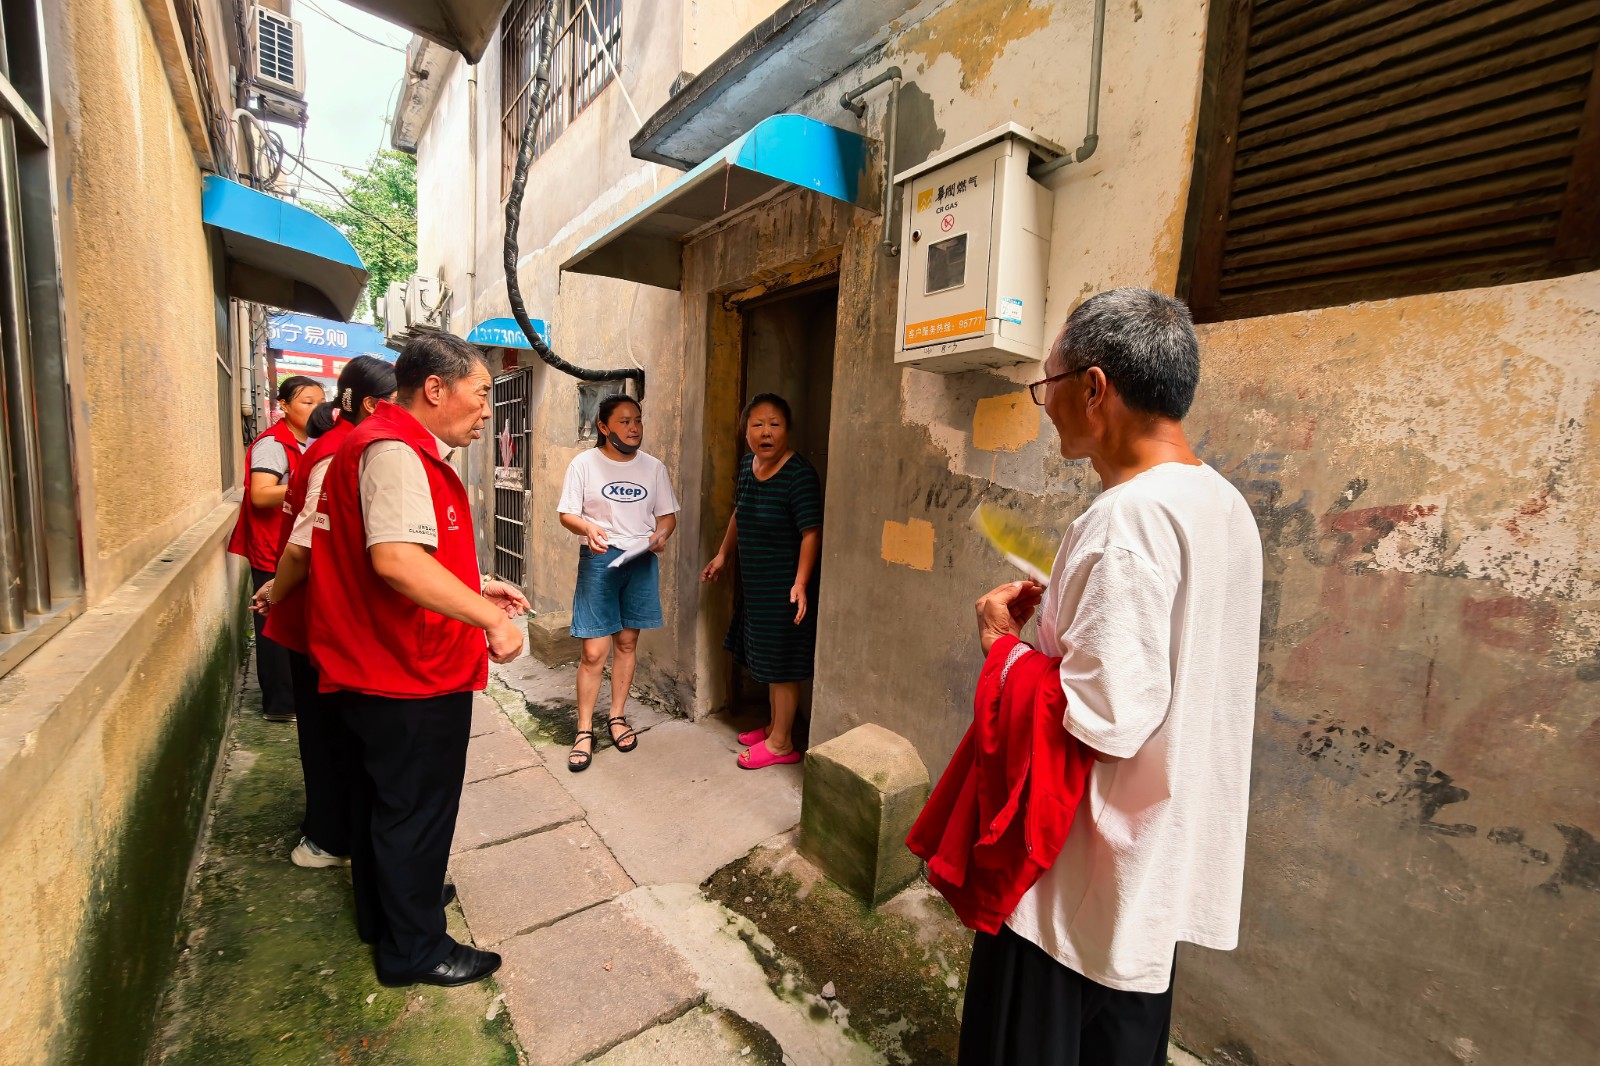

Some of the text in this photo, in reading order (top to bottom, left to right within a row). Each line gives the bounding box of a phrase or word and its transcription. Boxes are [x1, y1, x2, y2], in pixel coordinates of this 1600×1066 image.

[936, 201, 958, 214] CR GAS
[609, 485, 642, 497] Xtep
